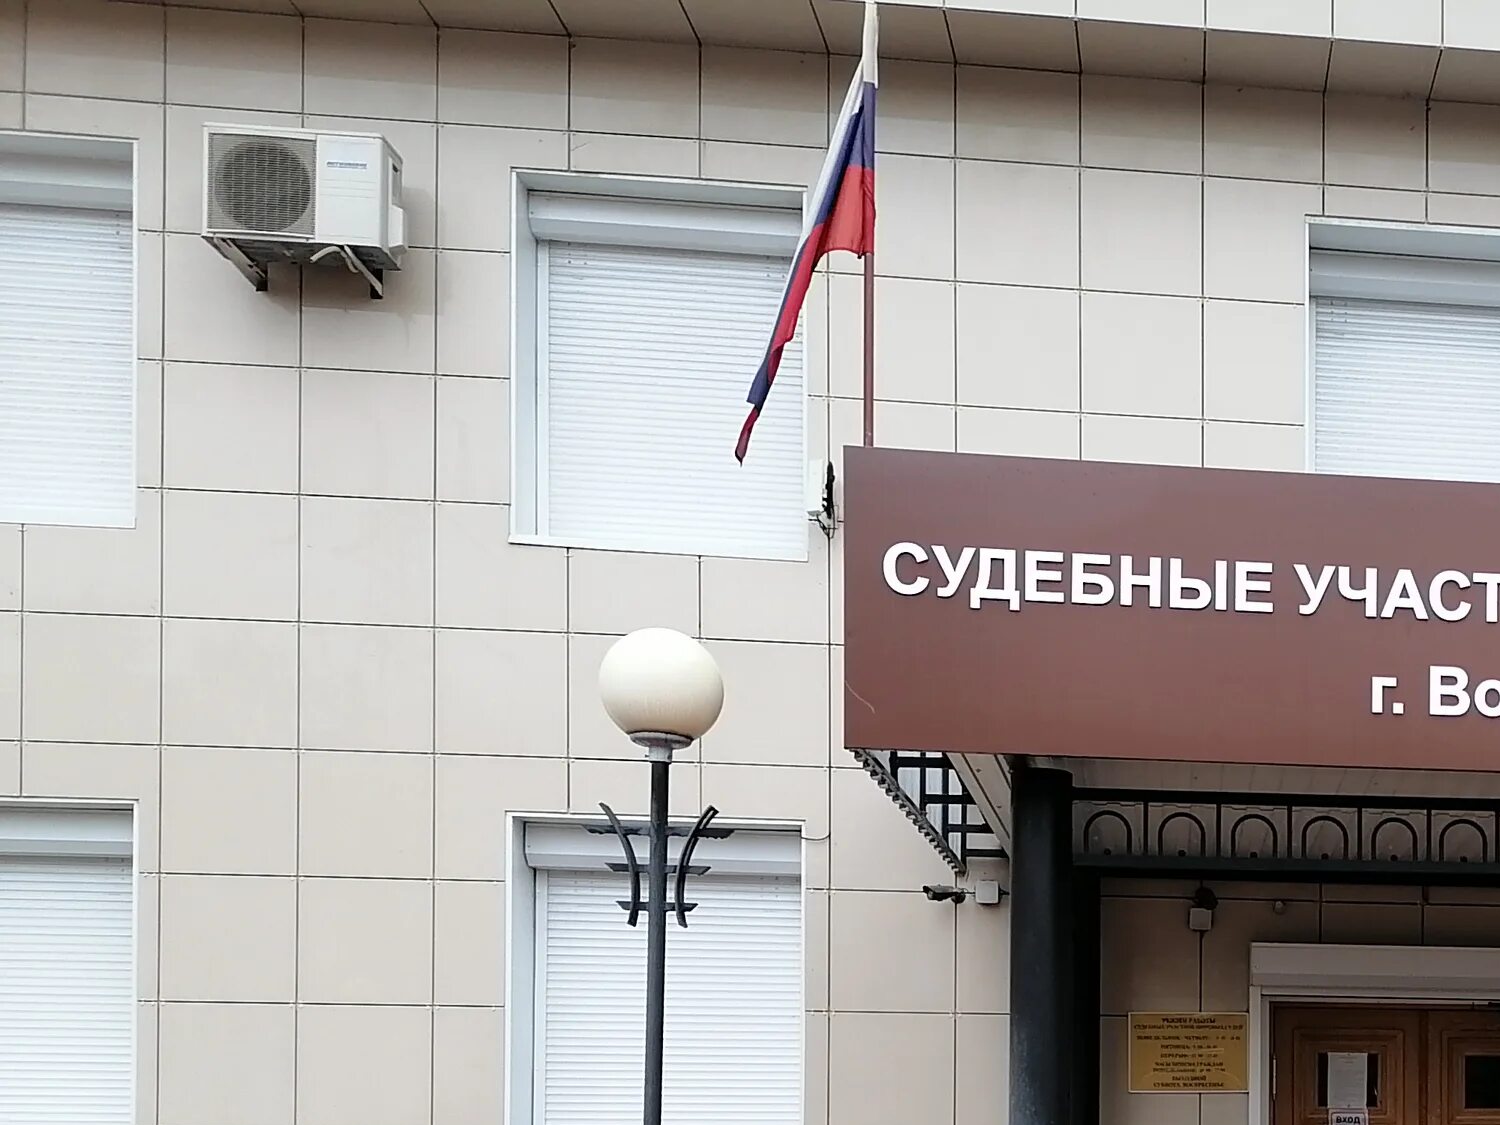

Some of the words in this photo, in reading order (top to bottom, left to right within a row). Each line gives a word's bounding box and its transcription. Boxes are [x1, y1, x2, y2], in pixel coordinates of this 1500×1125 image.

[882, 542, 1275, 614] СУДЕБНЫЕ
[1371, 676, 1405, 714] г.
[1336, 1115, 1361, 1125] ВХОД
